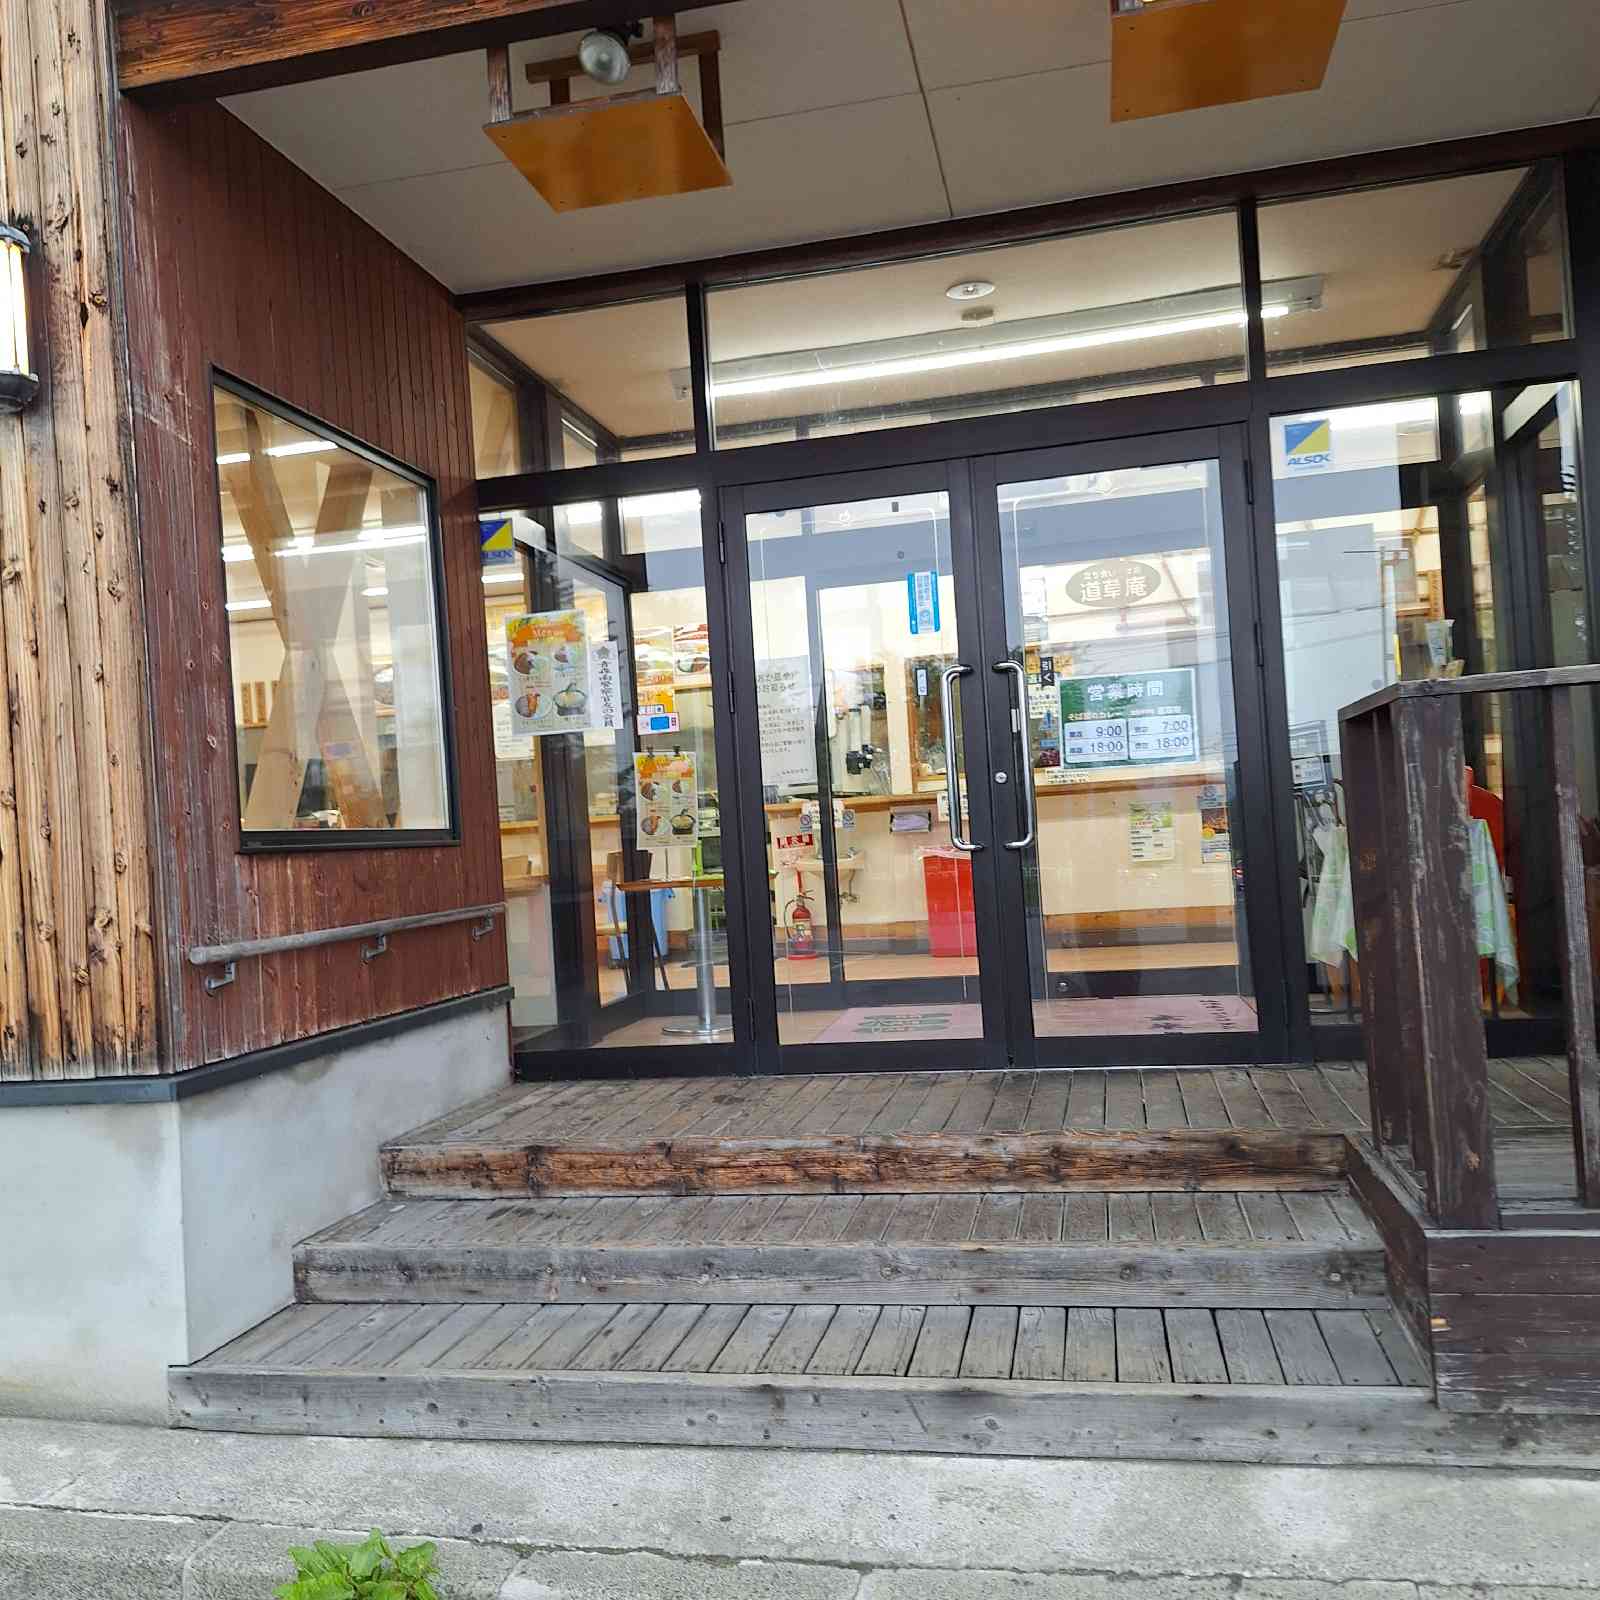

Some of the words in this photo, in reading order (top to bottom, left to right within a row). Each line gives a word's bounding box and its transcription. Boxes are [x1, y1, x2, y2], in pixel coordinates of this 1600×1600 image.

[1080, 575, 1147, 602] 道草庵
[1086, 679, 1164, 702] 営業時間
[1095, 725, 1123, 737] 9:00
[1161, 720, 1189, 731] 7:00
[1090, 740, 1124, 753] 18:00
[1156, 736, 1190, 749] 18:00
